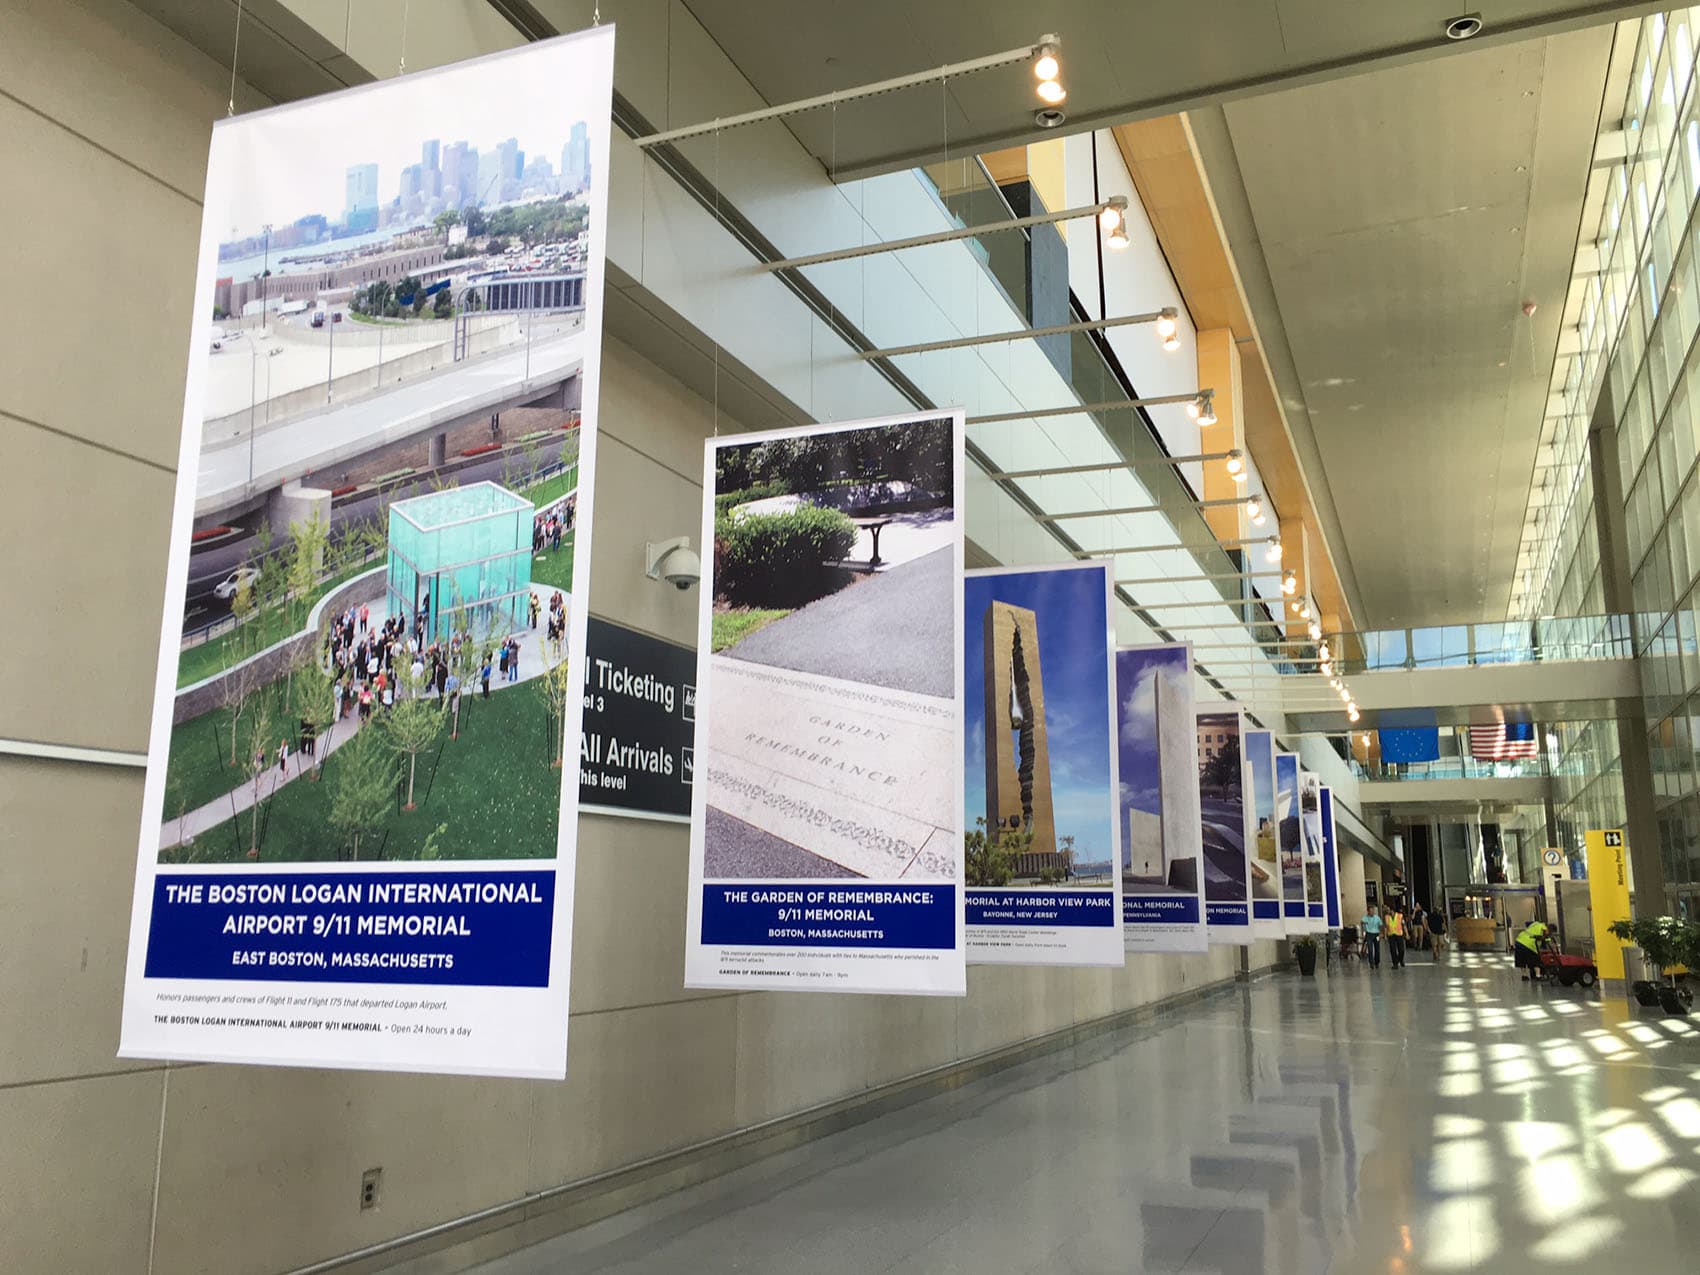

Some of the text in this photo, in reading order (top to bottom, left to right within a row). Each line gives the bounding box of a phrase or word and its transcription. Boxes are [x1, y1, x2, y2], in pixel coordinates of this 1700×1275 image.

[596, 659, 674, 713] Ticketing
[597, 696, 604, 712] 3
[808, 715, 891, 742] GARDEN
[818, 736, 844, 748] OF
[580, 732, 674, 775] All Arrivals
[744, 733, 898, 786] REMEMBRANCE
[580, 769, 626, 790] his level
[166, 882, 542, 904] THE BOSTON LOGAN INTERNATIONAL
[724, 892, 934, 904] THE GARDEN OF REMEMBRANCE:
[1002, 898, 1013, 906] AT
[1016, 898, 1056, 906] HARBOR
[1058, 898, 1083, 906] VIEW
[1086, 898, 1110, 906] PARK
[778, 908, 874, 921] 9/11 MEMORIAL
[223, 913, 470, 937] AIRPORT 9/11 MEMORIAL
[768, 929, 884, 939] BOSTON, MASSACHUSETTS
[232, 952, 454, 969] EAST BOSTON, MASSACHUSETTS
[156, 993, 180, 1001] Honors
[182, 994, 220, 1004] passengers
[222, 995, 235, 1003] and
[257, 996, 266, 1004] of
[266, 996, 286, 1006] Flight
[294, 997, 306, 1006] and
[308, 998, 328, 1007] Flight
[330, 998, 342, 1006] 175
[344, 998, 358, 1007] that
[360, 999, 394, 1010] departed
[395, 1000, 418, 1010] Logan
[419, 1000, 448, 1010] Airport.
[154, 1015, 168, 1024] THE
[170, 1016, 200, 1024] BOSTON
[202, 1017, 226, 1026] LOGAN
[228, 1018, 286, 1028] INTERNATIONAL
[290, 1020, 322, 1029] AIRPORT
[325, 1022, 340, 1031] 9/11
[342, 1022, 382, 1032] MEMORIAL
[391, 1024, 410, 1034] Open
[413, 1024, 423, 1033] 24
[426, 1025, 448, 1034] hours
[457, 1026, 472, 1037] day
